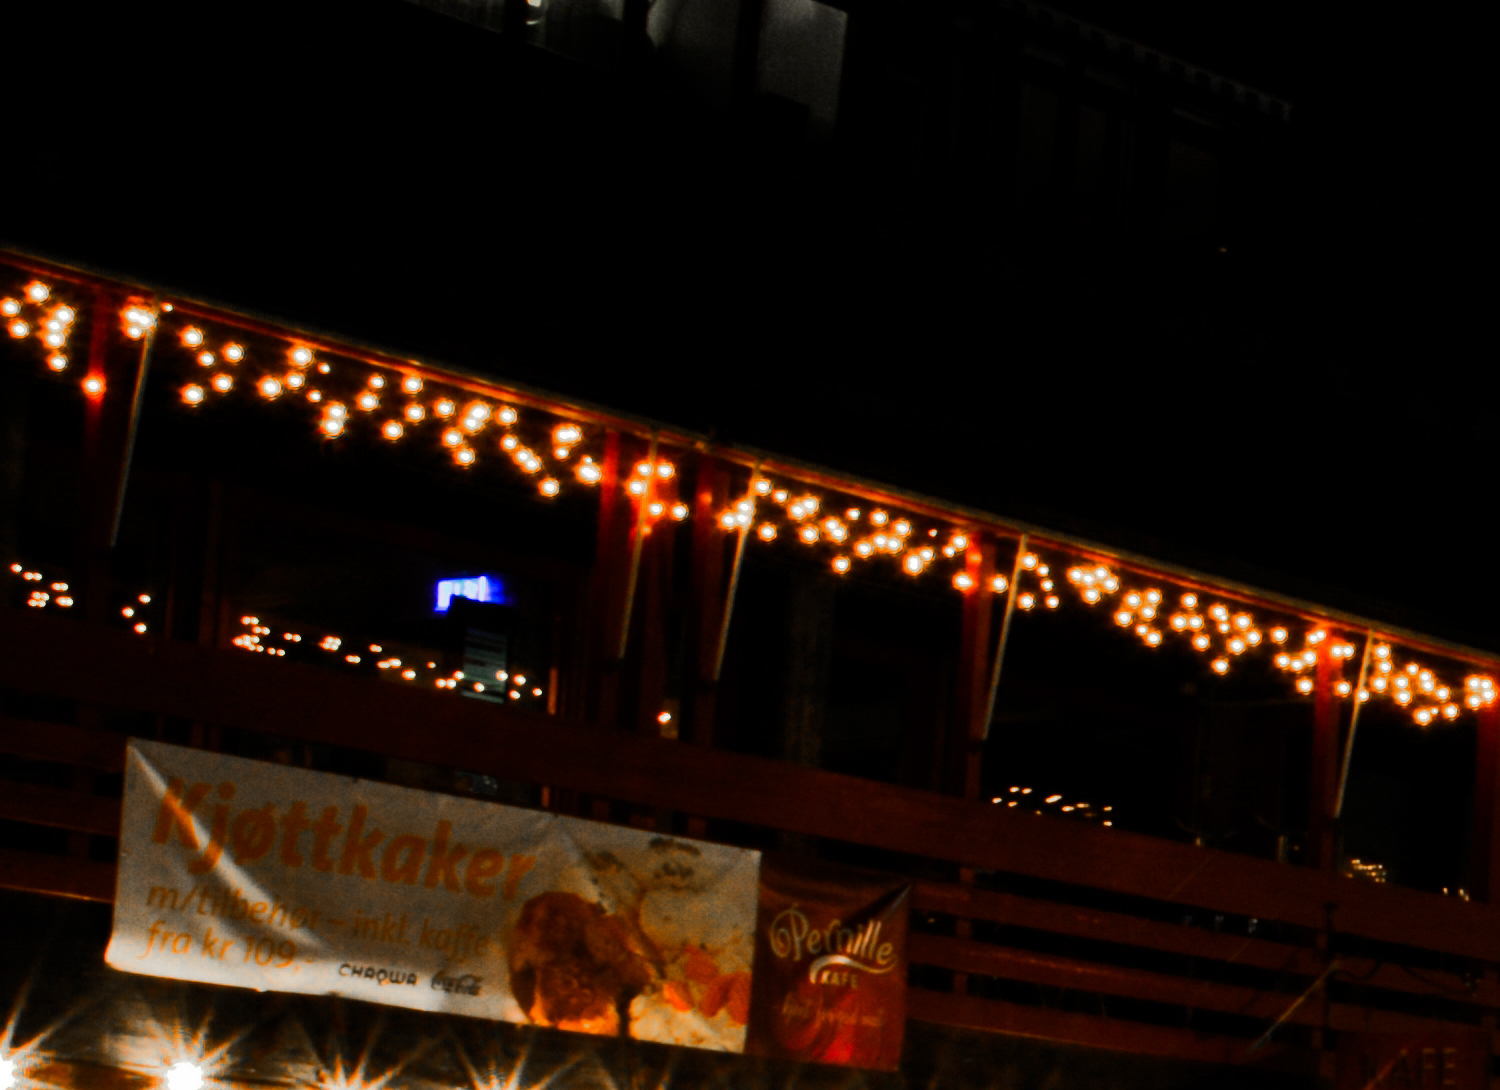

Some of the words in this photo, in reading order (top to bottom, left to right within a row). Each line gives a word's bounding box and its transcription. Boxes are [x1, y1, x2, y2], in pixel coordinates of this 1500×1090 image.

[151, 776, 537, 901] Kjøttkaker
[137, 920, 191, 960] fra
[202, 927, 235, 962] kr
[419, 918, 491, 964] kaffe
[769, 902, 894, 966] Pernille
[338, 962, 419, 986] CHAQWA
